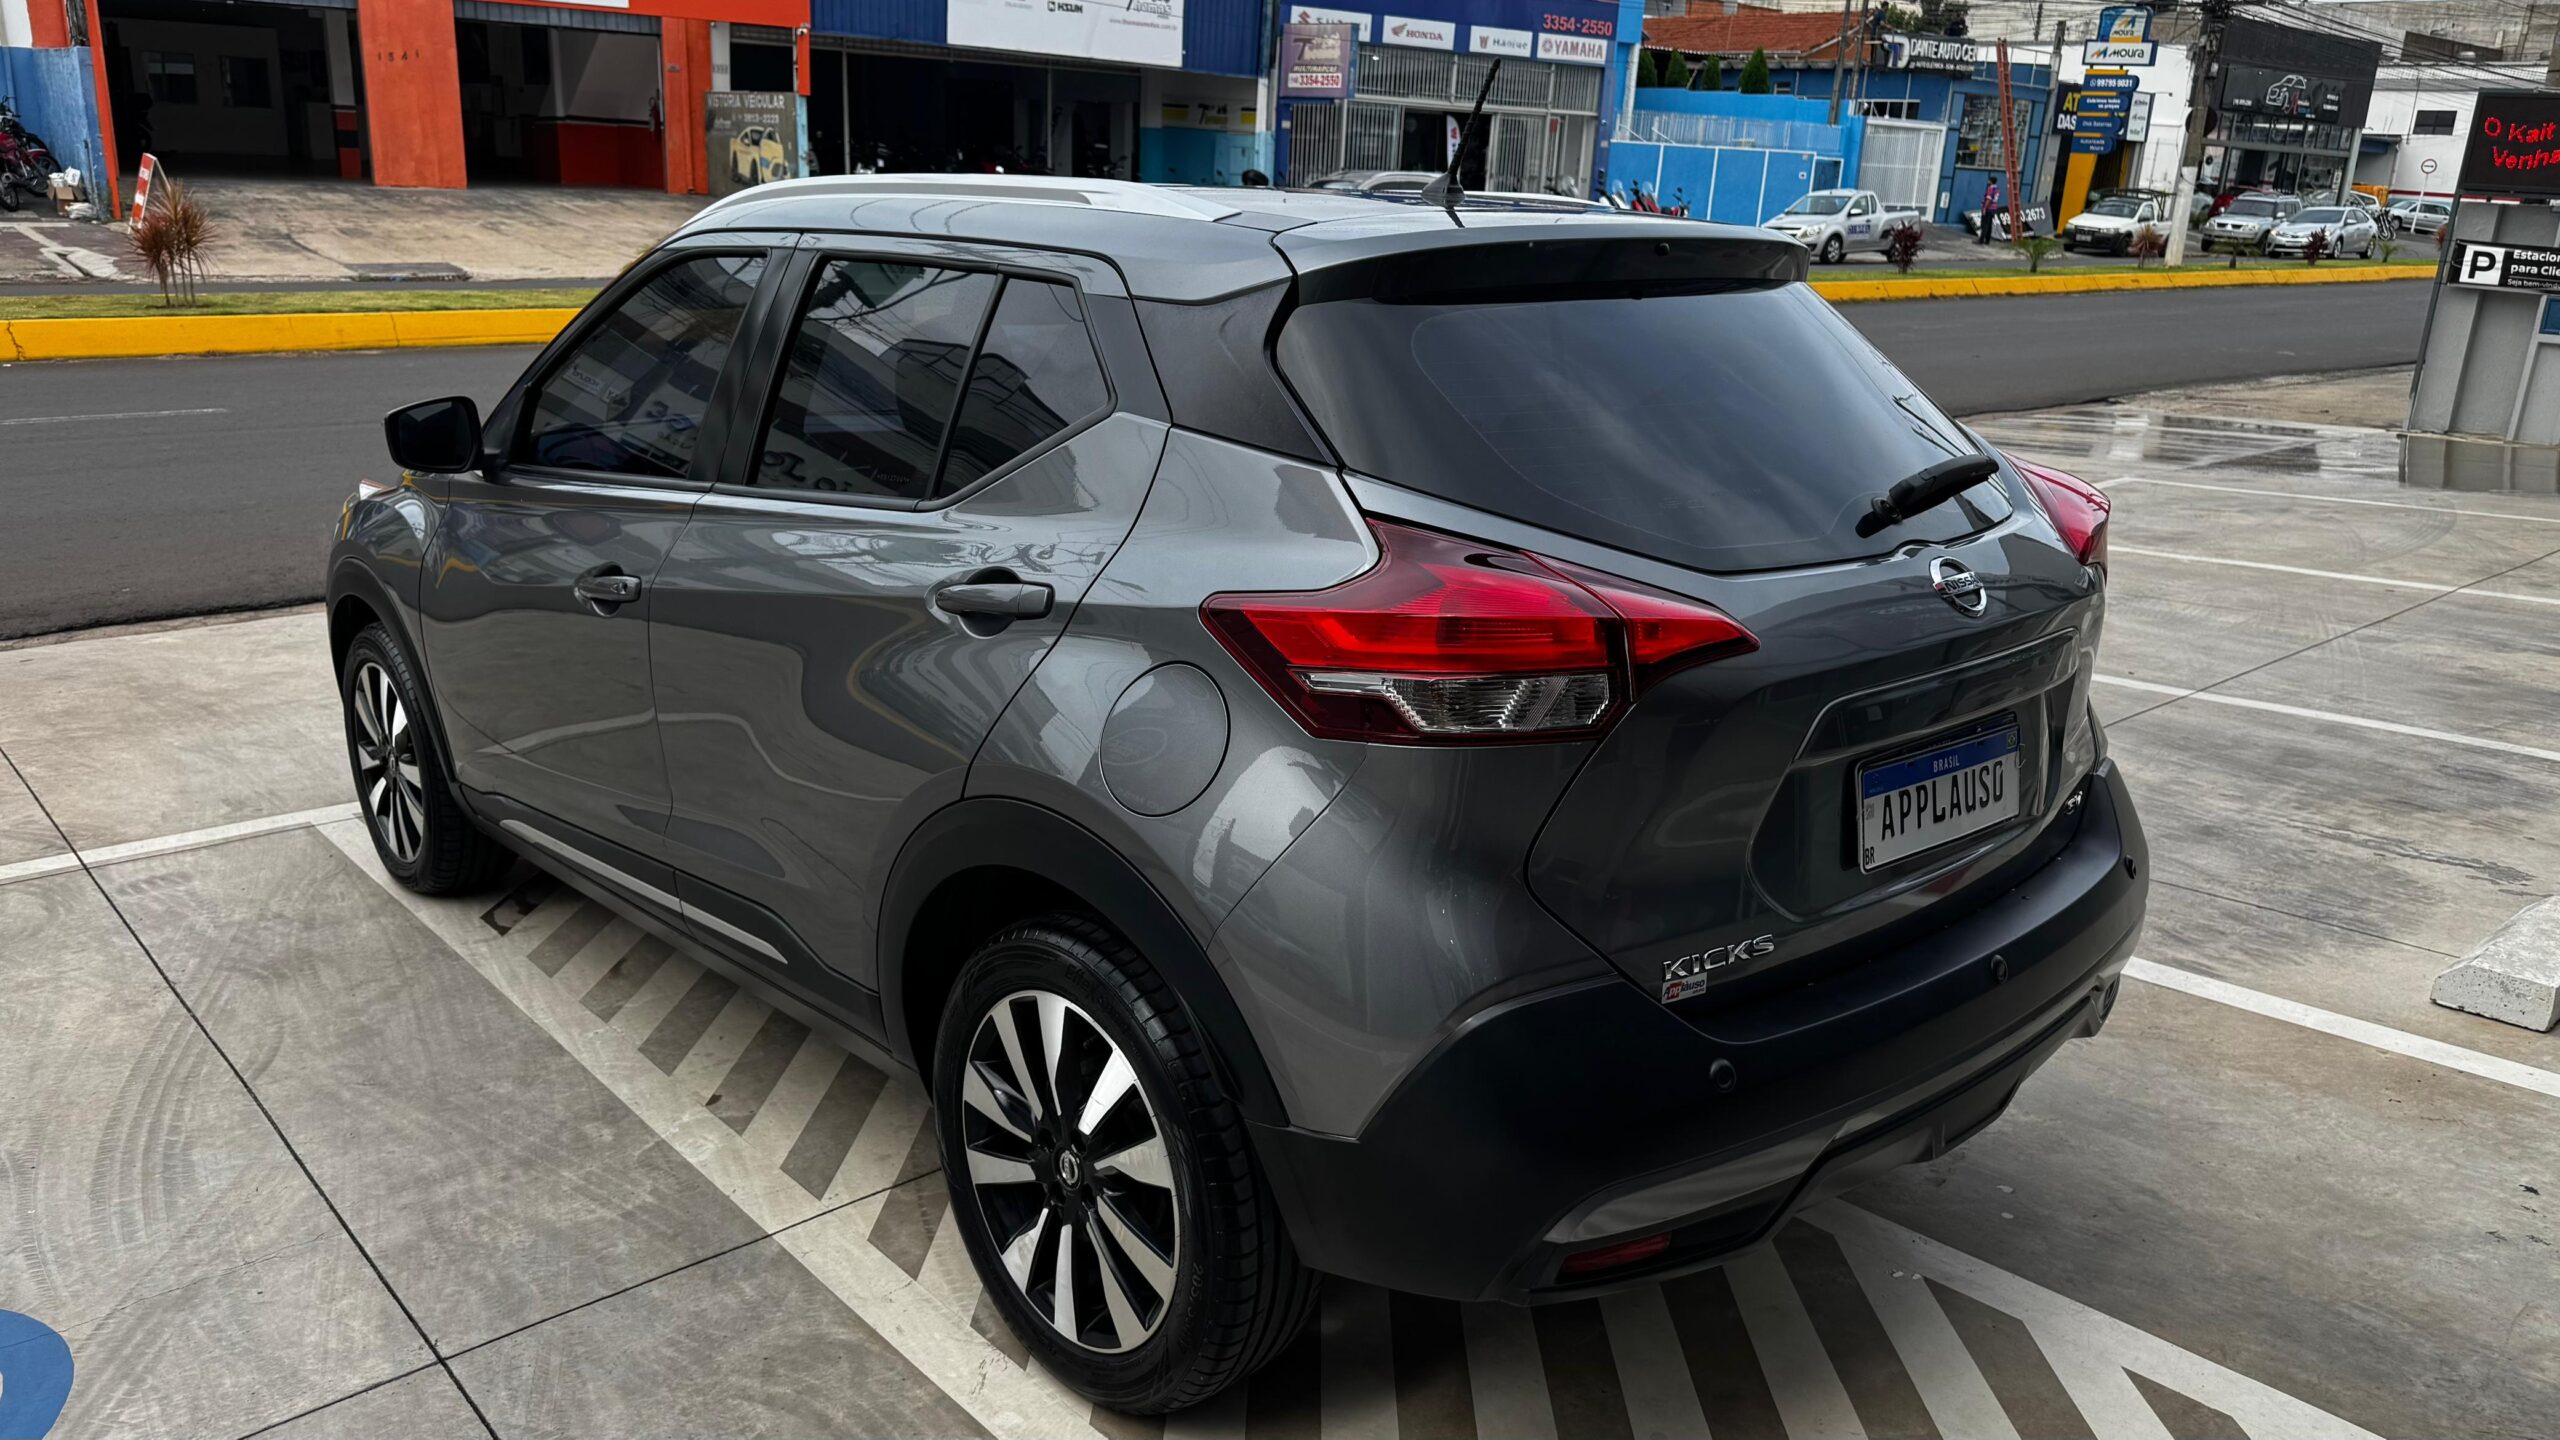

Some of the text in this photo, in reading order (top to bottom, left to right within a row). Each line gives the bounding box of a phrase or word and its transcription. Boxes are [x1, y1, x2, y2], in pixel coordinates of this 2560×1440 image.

[1406, 29, 1443, 41] HONDA
[1543, 14, 1613, 36] 3354-2550
[1554, 40, 1604, 59] YAMAHA
[1910, 38, 1939, 59] DANTE
[1937, 41, 1961, 61] AUTO
[2508, 122, 2556, 143] Kait
[2467, 251, 2497, 279] P
[2511, 264, 2538, 274] para
[1933, 755, 1960, 773] BRASIL
[1881, 760, 2003, 842] APPLAUSO
[1865, 846, 1875, 865] BR
[1662, 934, 1775, 980] KICKS
